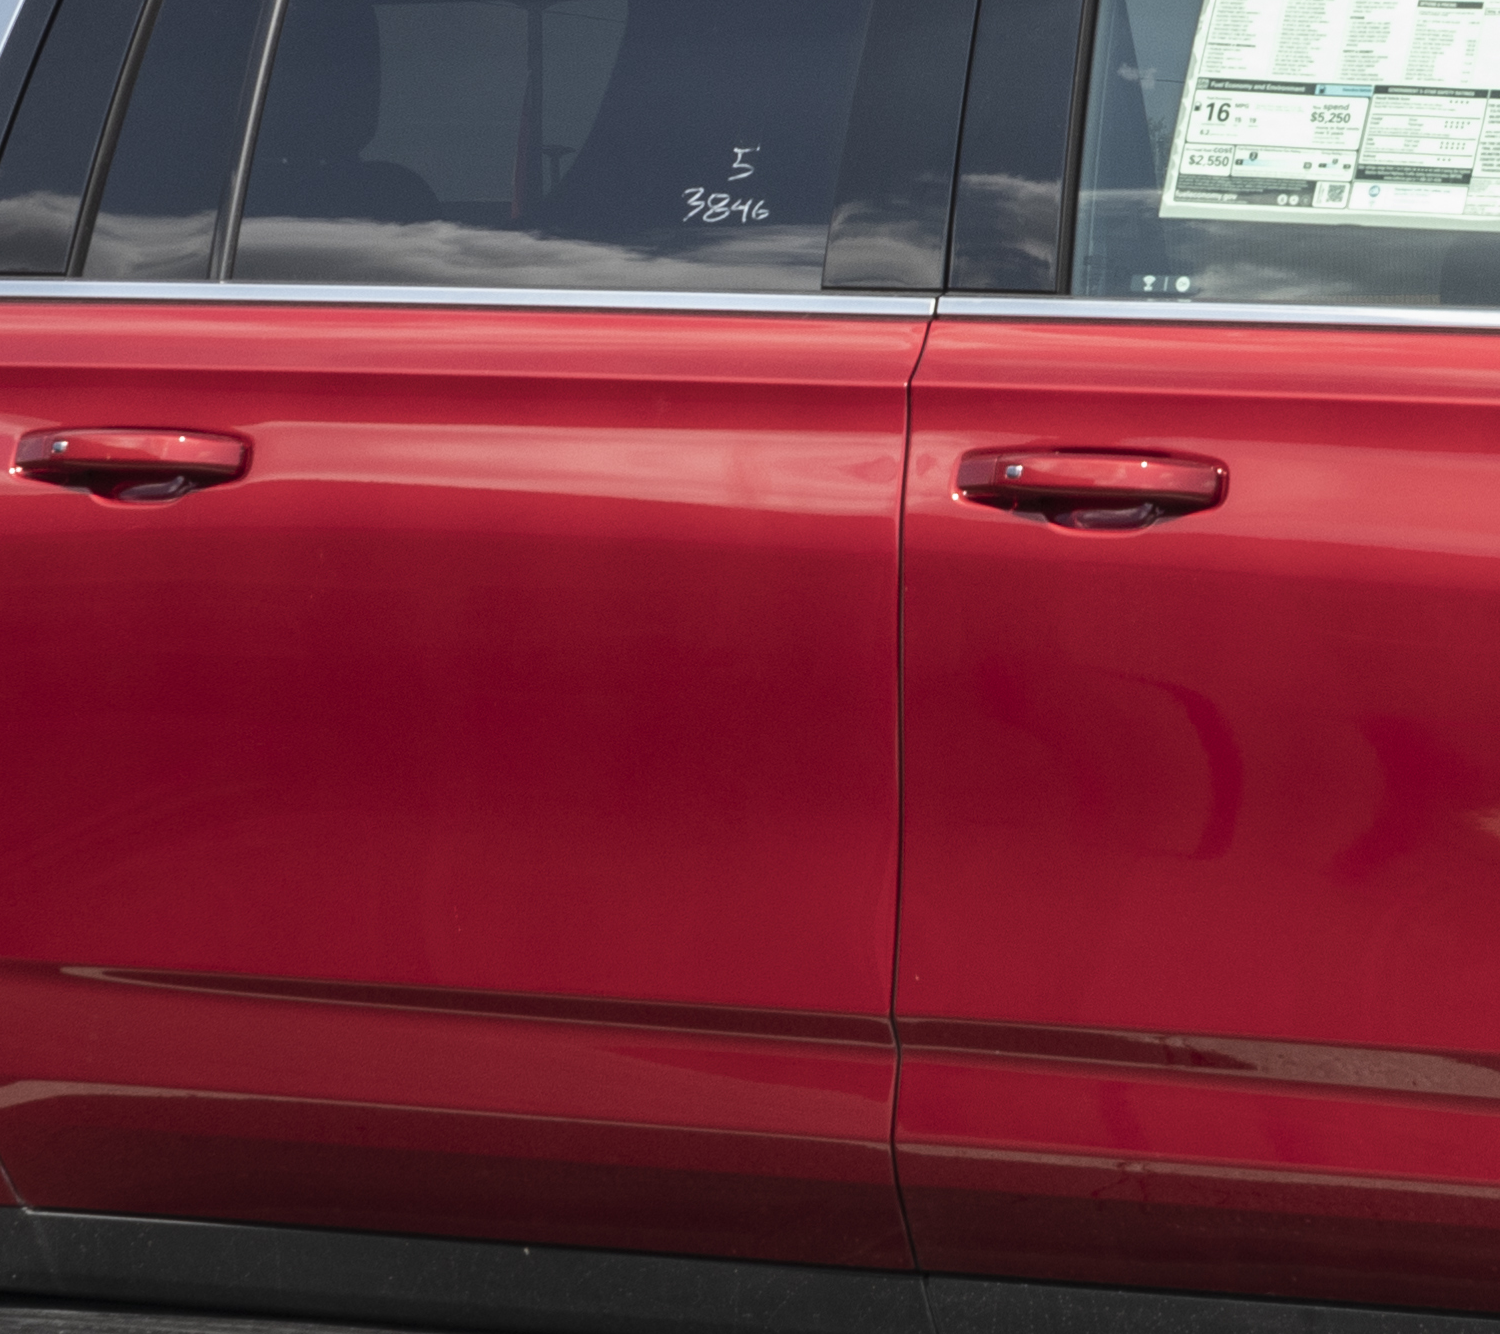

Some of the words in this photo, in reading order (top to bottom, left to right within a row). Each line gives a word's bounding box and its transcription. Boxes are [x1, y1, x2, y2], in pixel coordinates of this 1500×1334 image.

[1224, 81, 1252, 91] Economy
[1266, 83, 1306, 92] Environment
[1205, 102, 1231, 122] 16
[1323, 103, 1350, 112] spend
[1310, 112, 1351, 124] $5,250
[728, 142, 761, 181] 5
[1188, 154, 1230, 167] $2,550
[1175, 189, 1238, 202] fueleconomy.gov
[681, 187, 770, 224] 3846
